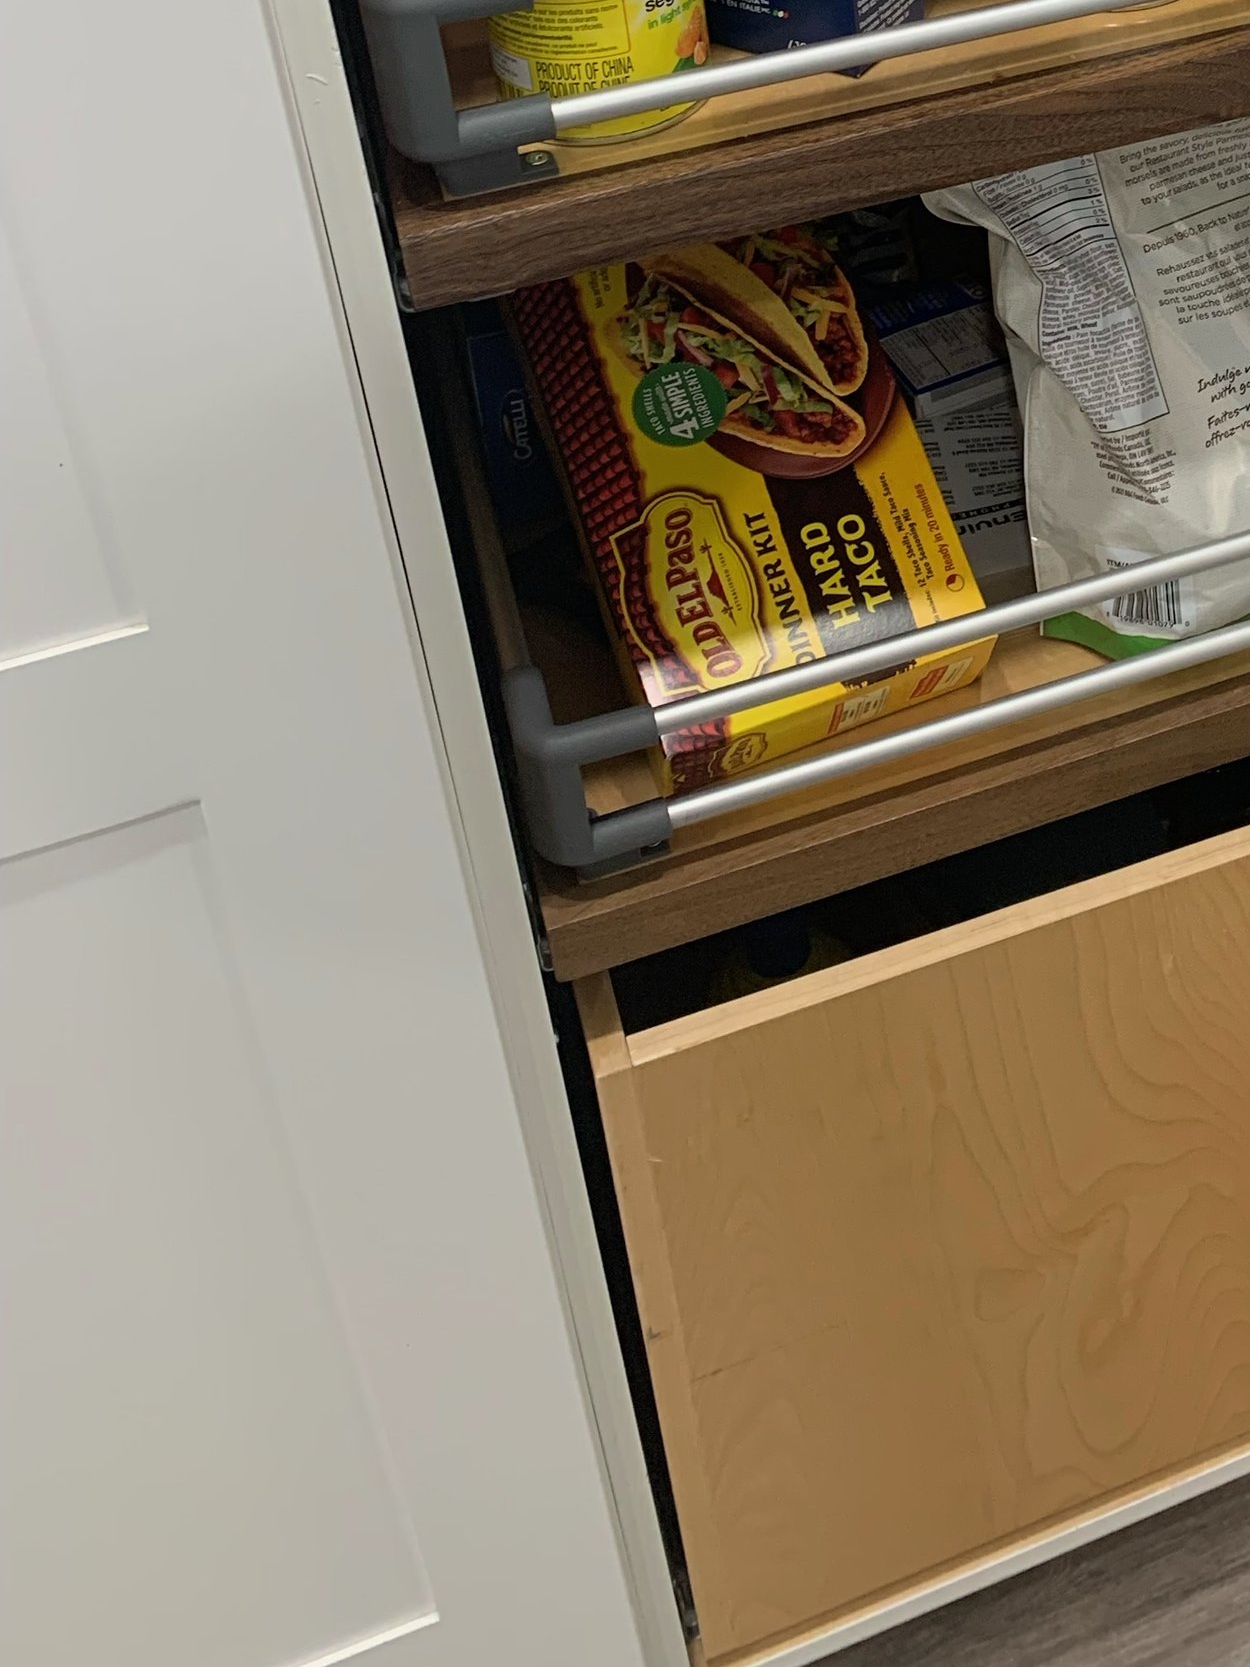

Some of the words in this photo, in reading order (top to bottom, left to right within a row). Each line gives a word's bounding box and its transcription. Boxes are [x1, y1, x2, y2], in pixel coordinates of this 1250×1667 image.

[647, 18, 658, 30] in
[660, 6, 681, 24] light
[535, 61, 582, 81] PRODUCT
[584, 61, 600, 81] OF
[601, 55, 635, 79] CHINA
[1119, 150, 1142, 165] Bring
[1124, 171, 1158, 188] morsels
[1171, 156, 1195, 171] made
[1195, 149, 1217, 163] from
[1217, 139, 1248, 156] freshly
[1145, 145, 1190, 167] Restaurant
[1191, 138, 1214, 154] Style
[1148, 170, 1189, 192] parmesan
[1189, 160, 1217, 178] cheese
[1152, 187, 1173, 205] your
[1223, 162, 1243, 177] ideal
[1142, 233, 1176, 254] Depuis
[1197, 219, 1219, 234] Back
[1156, 254, 1206, 278] Rehaussez
[1162, 274, 1220, 297] savoureuses
[1158, 295, 1182, 308] sont
[1187, 298, 1222, 312] touche
[1211, 301, 1244, 319] soupes
[1196, 366, 1243, 393] Indulge
[1210, 382, 1238, 403] with
[643, 388, 656, 417] SHELLS
[661, 371, 694, 419] SIMPLE
[682, 367, 715, 429] INGREDIENTS
[651, 415, 667, 436] TACO
[669, 417, 701, 440] 4
[878, 471, 893, 498] Sauce,
[886, 496, 899, 517] Taco
[901, 507, 914, 524] Mix
[913, 482, 935, 522] minutes
[742, 511, 778, 557] KIT
[893, 515, 904, 534] Mild
[928, 519, 941, 534] 20
[664, 507, 702, 592] PASO
[902, 531, 917, 561] Shells,
[907, 522, 930, 562] Seasoning
[836, 513, 894, 614] TACO
[913, 559, 925, 580] Taco
[923, 559, 935, 581] Taco
[937, 543, 957, 573] Ready
[800, 521, 862, 630] HARD
[916, 577, 928, 588] 12
[674, 582, 713, 628] EL
[763, 557, 817, 665] DINNER
[692, 621, 743, 678] OLD
